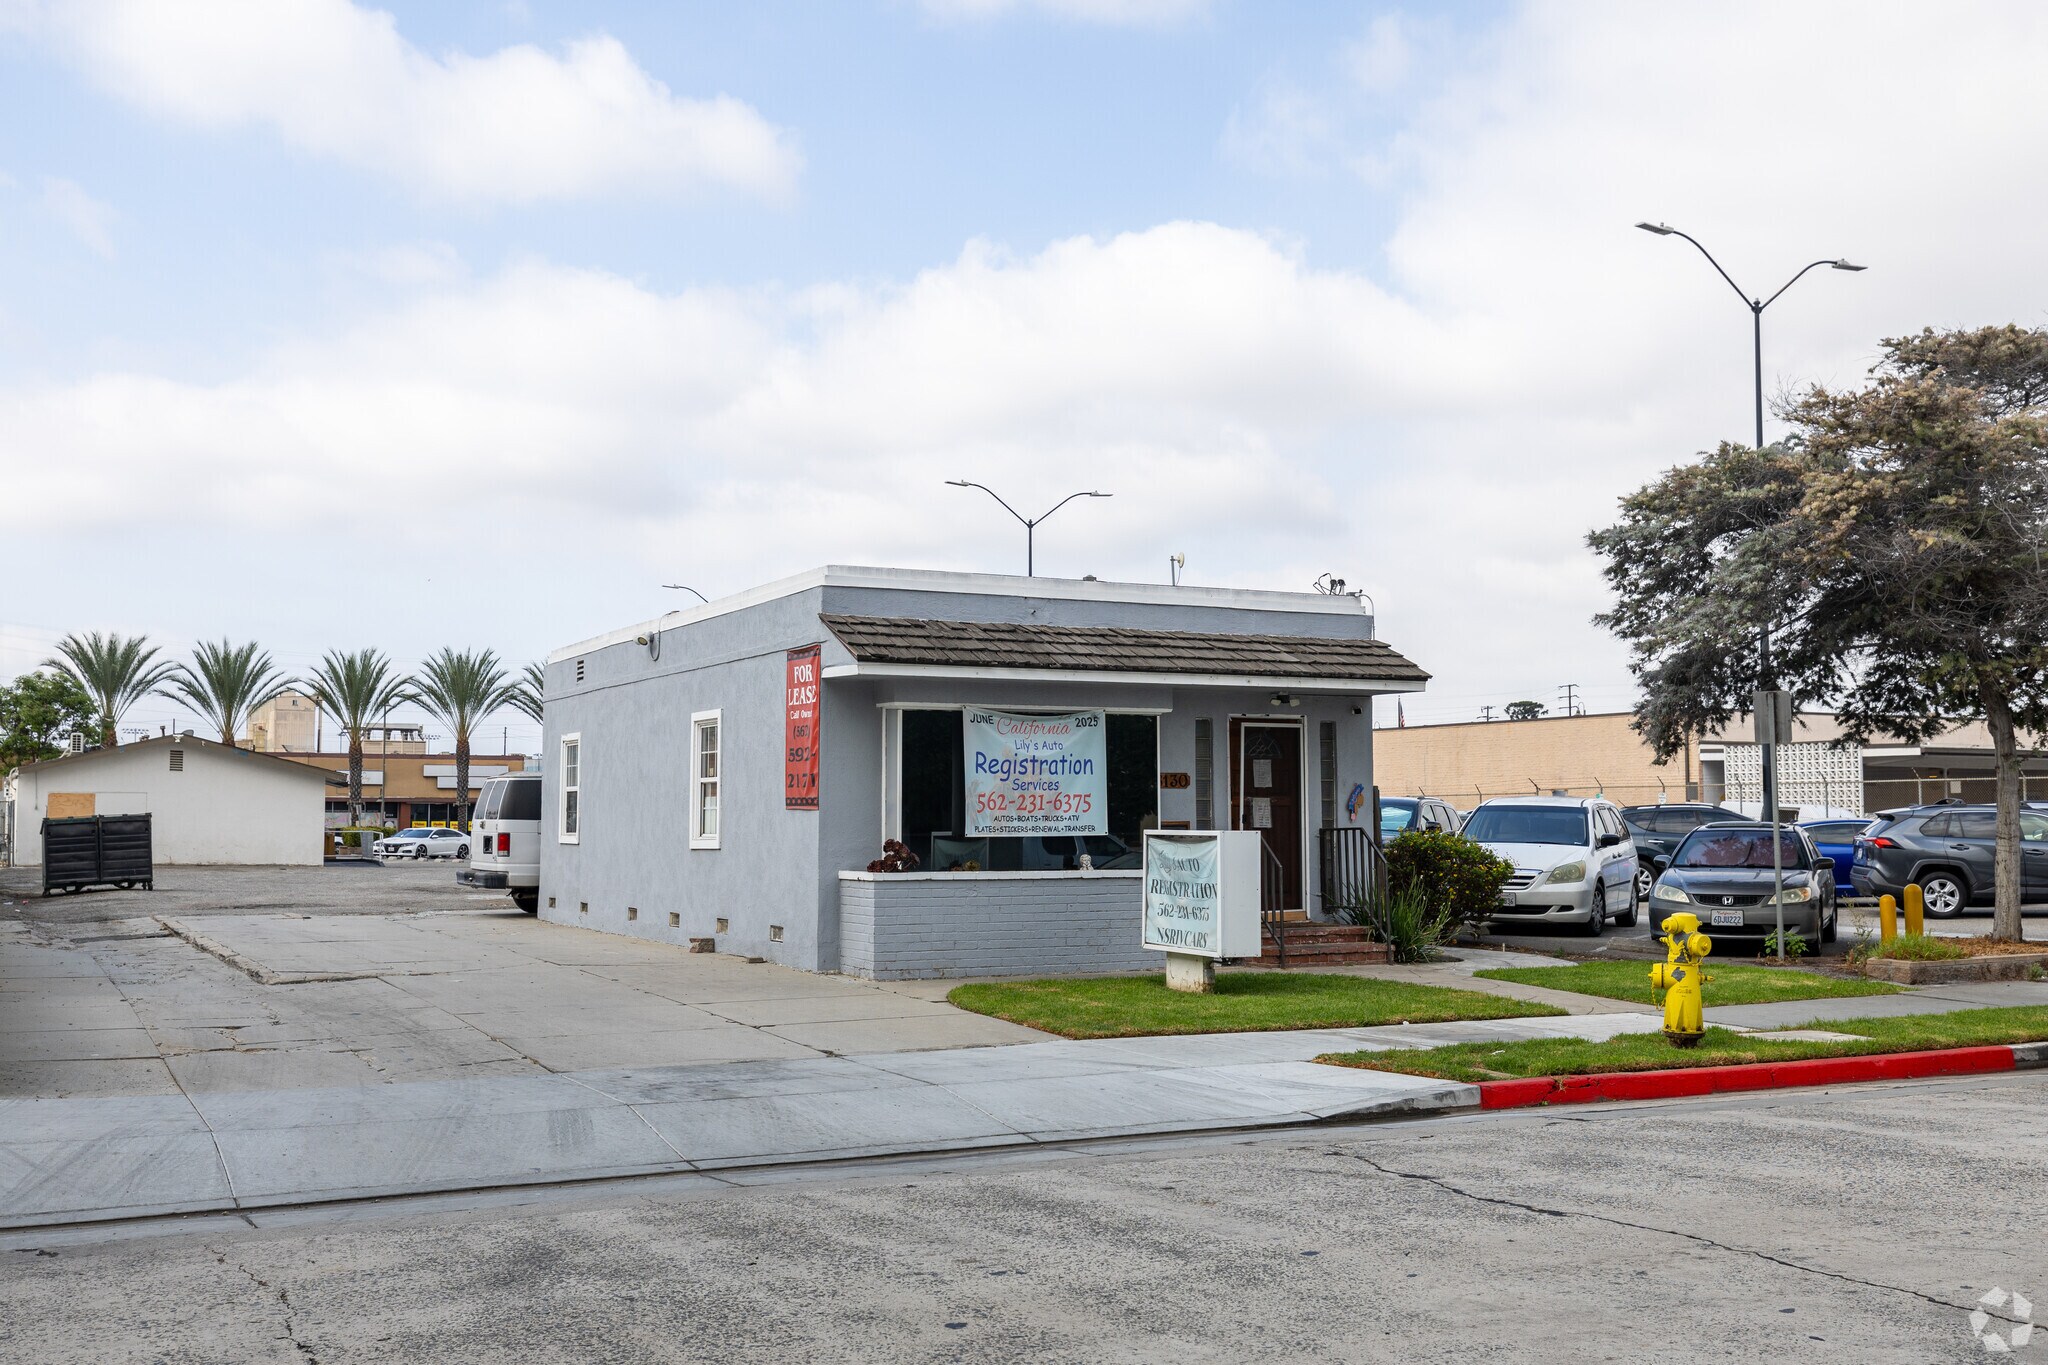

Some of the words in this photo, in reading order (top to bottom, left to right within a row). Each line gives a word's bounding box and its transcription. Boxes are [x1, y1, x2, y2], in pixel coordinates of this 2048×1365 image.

[794, 664, 813, 683] FOR
[970, 713, 994, 725] JUNE
[996, 716, 1071, 739] California
[1074, 716, 1099, 728] 2025
[1014, 739, 1039, 753] Lily's
[1041, 740, 1064, 750] Auto
[975, 751, 1094, 782] Registration
[788, 773, 816, 788] 2171
[1012, 778, 1060, 791] Services
[976, 791, 1092, 814] 562-231-6375
[1157, 902, 1210, 922] 562-231-6375
[1713, 915, 1741, 924] 6DJU222
